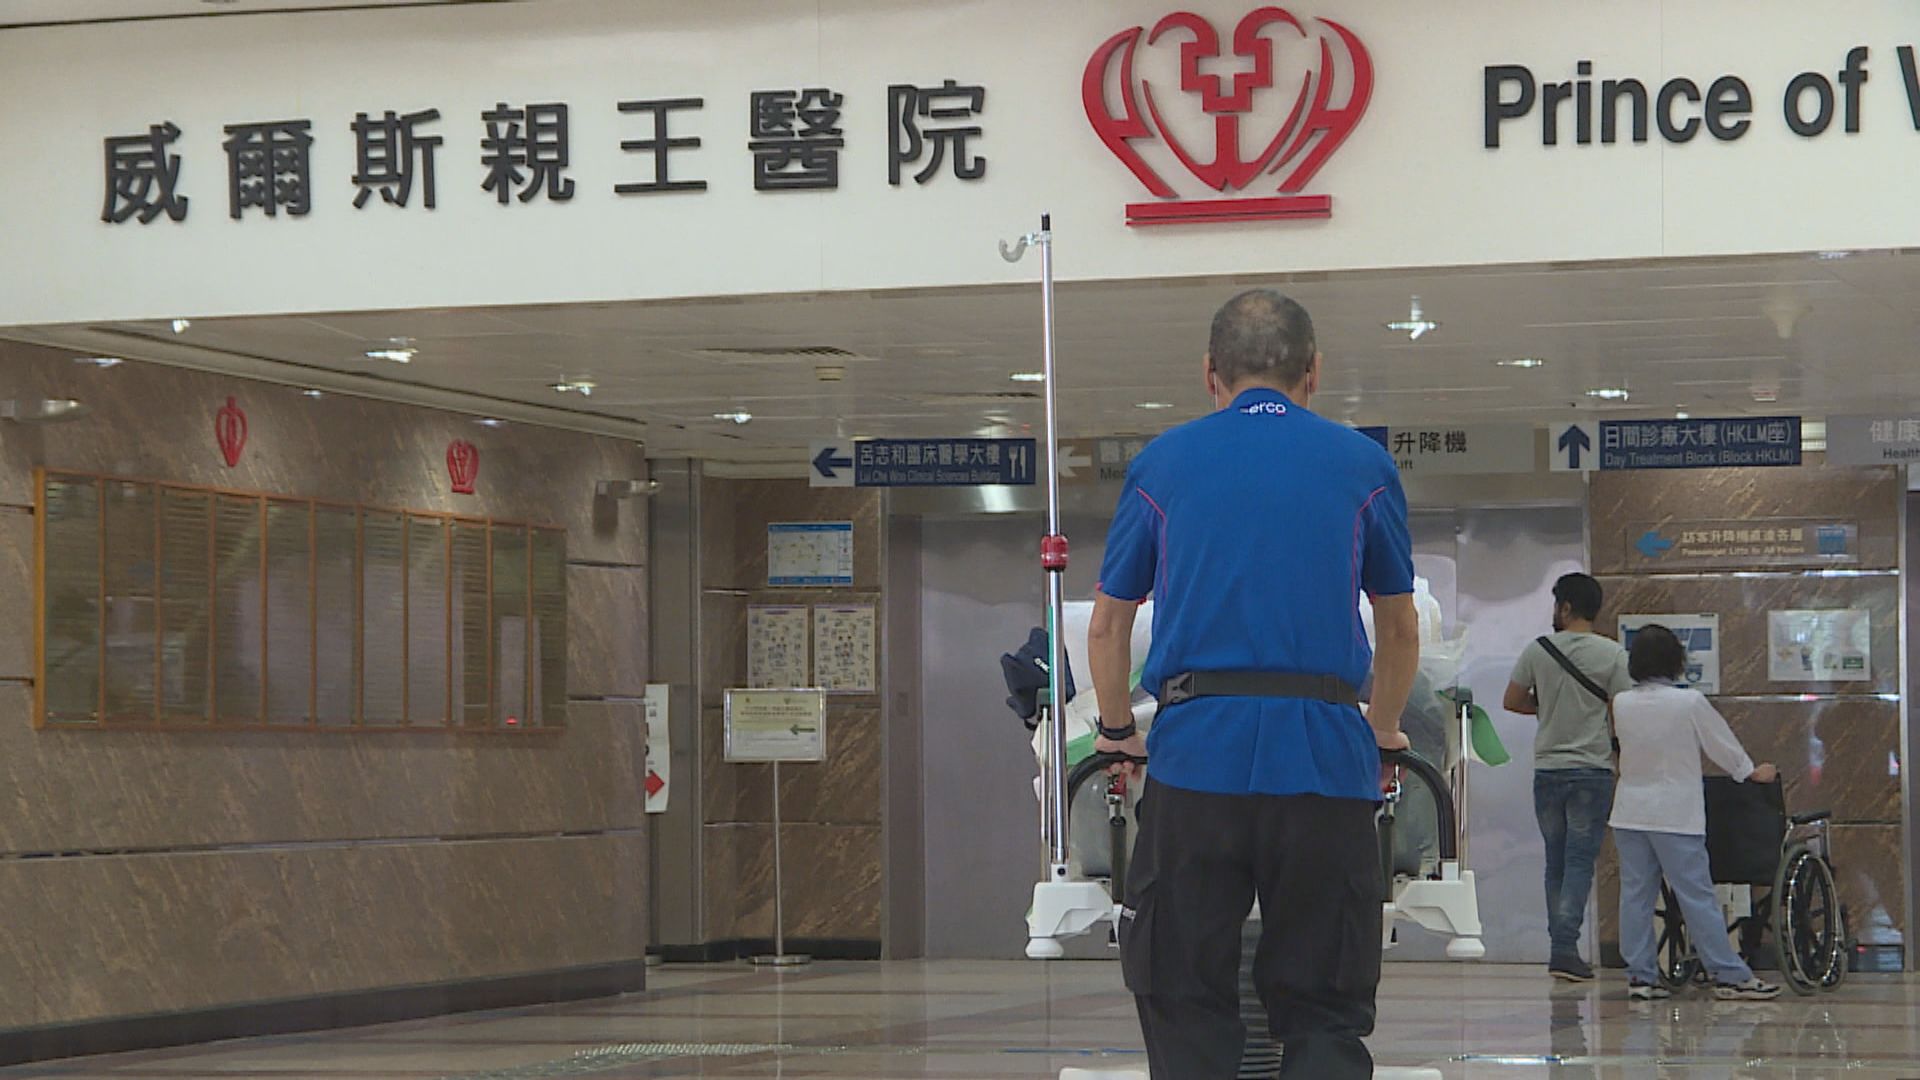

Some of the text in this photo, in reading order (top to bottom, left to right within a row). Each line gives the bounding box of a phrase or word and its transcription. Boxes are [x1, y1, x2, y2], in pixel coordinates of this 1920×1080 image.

[1485, 61, 1753, 148] Prince
[1784, 47, 1868, 137] of
[102, 80, 985, 225] 威爾斯親王醫院
[1393, 430, 1467, 454] 升降機
[1605, 448, 1794, 468] Day Treatment Block (Block HKLM)
